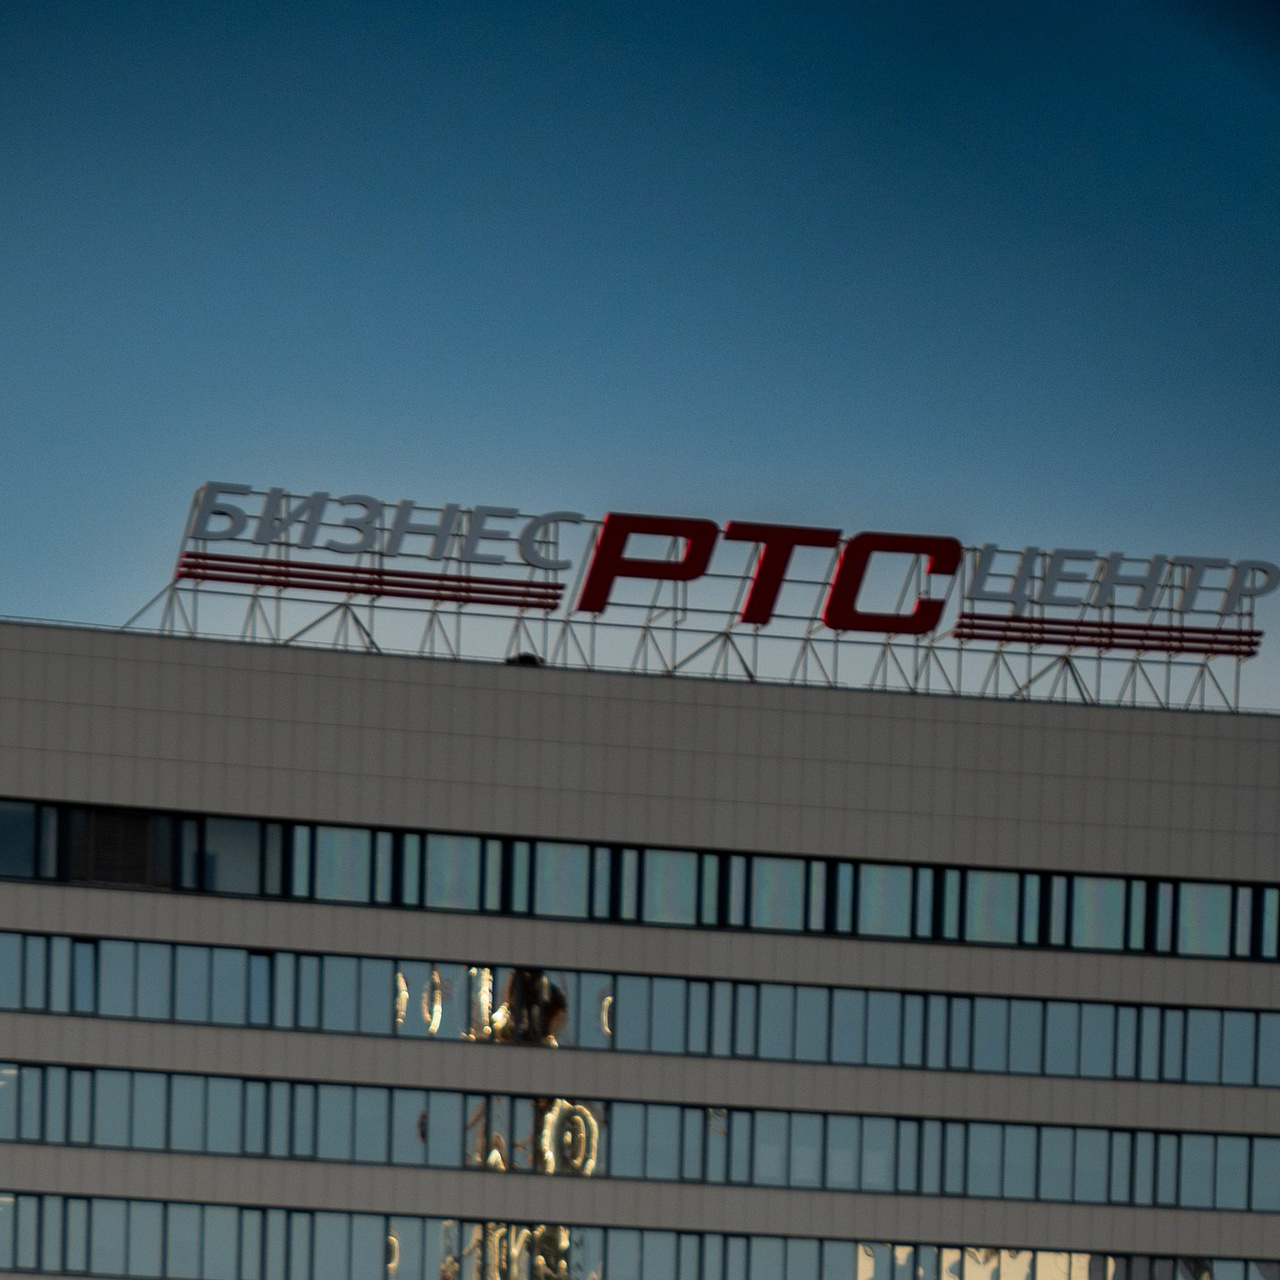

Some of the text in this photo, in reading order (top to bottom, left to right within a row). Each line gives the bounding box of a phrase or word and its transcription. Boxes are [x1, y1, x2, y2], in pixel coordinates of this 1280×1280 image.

[189, 481, 1280, 634] БИЗНЕС РТС ЦЕНТР
